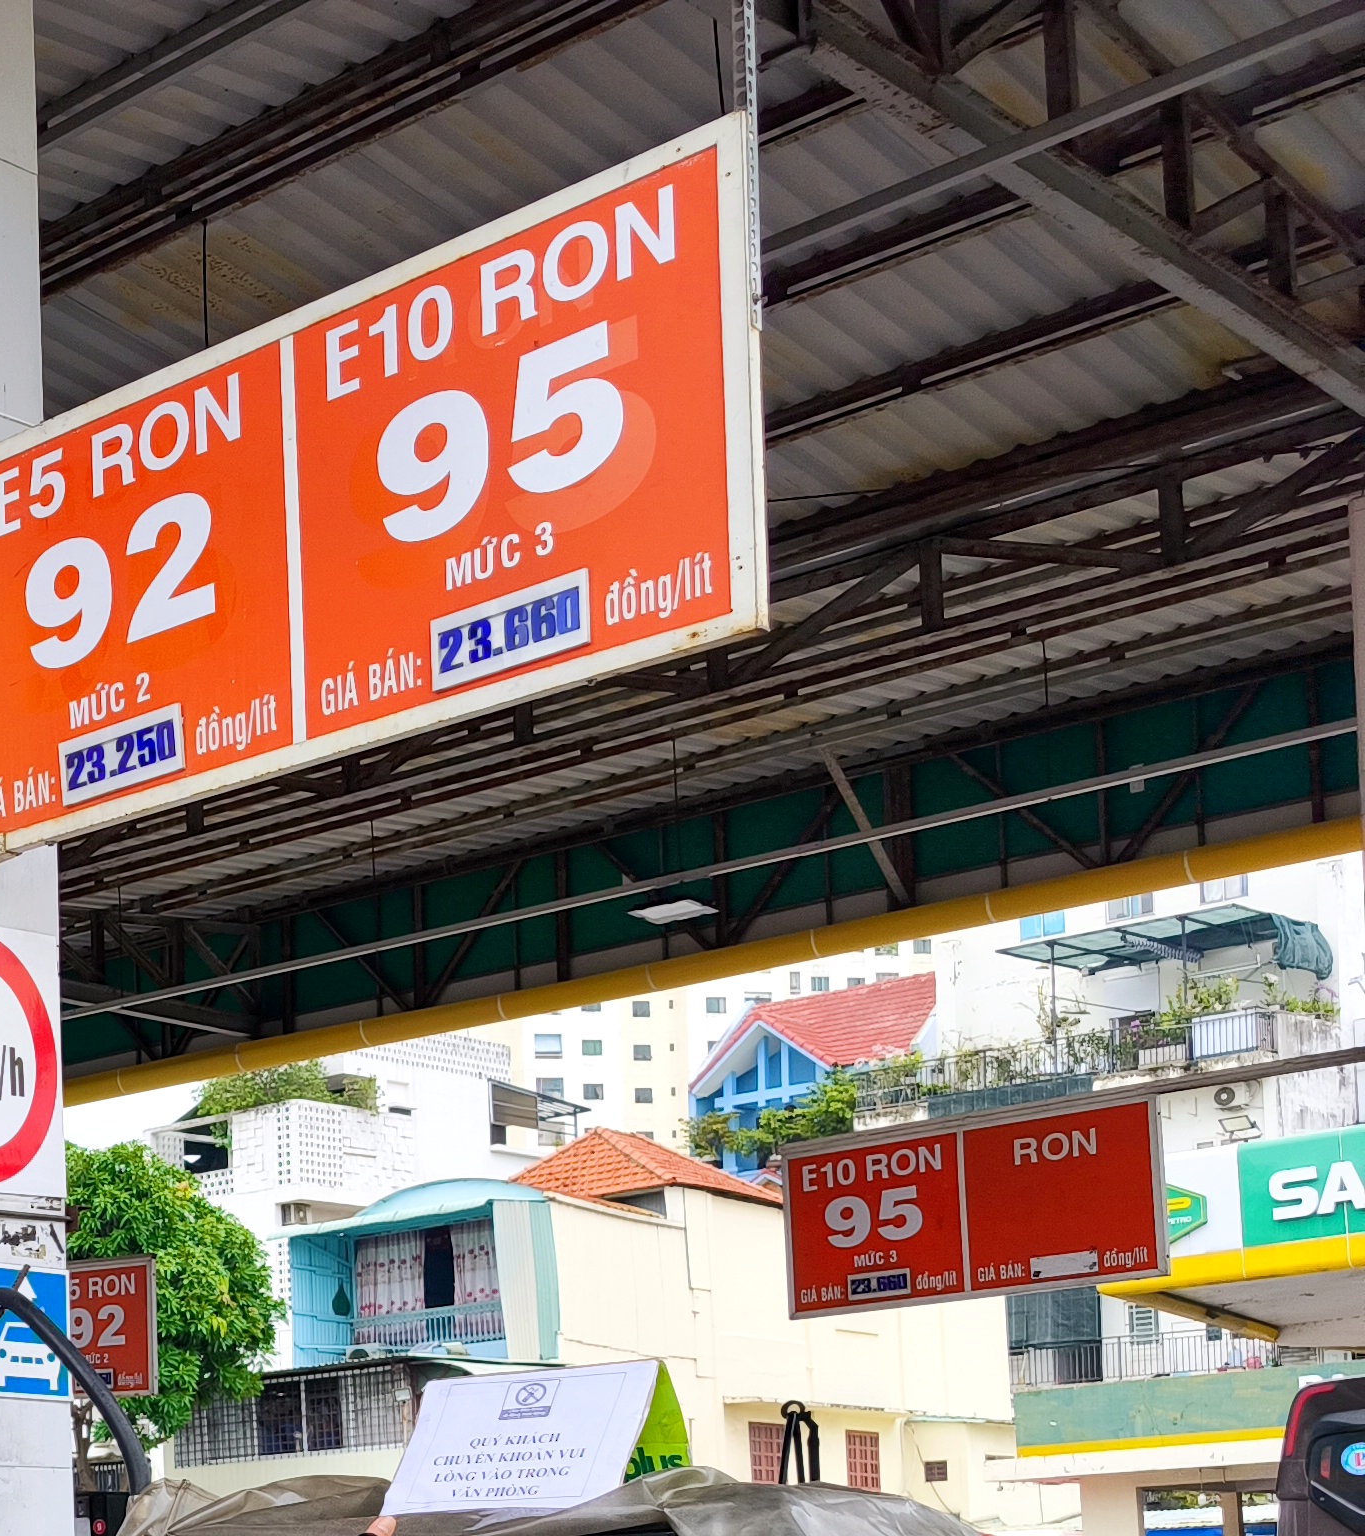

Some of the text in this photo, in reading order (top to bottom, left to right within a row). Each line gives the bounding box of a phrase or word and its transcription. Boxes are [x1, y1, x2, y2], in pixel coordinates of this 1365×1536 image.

[326, 184, 677, 403] E10 RON
[90, 371, 242, 500] RON
[376, 320, 626, 544] 95
[24, 493, 217, 671] 92
[444, 521, 554, 592] MỨC 3
[319, 556, 713, 716] GIÁ BÁN: 23.660 đồng/lít
[69, 674, 151, 730] MỨC 2
[13, 760, 57, 815] BÁN:
[66, 722, 177, 792] 23.250
[195, 694, 278, 756] đồng/lít
[802, 1144, 943, 1193] E10 RON
[1013, 1127, 1098, 1165] RON
[824, 1185, 924, 1249] 95
[88, 1273, 136, 1299] RON
[890, 1250, 898, 1263] 3
[977, 1264, 996, 1282] GIÁ
[1104, 1246, 1149, 1269] đồng/lít
[70, 1304, 126, 1349] 92
